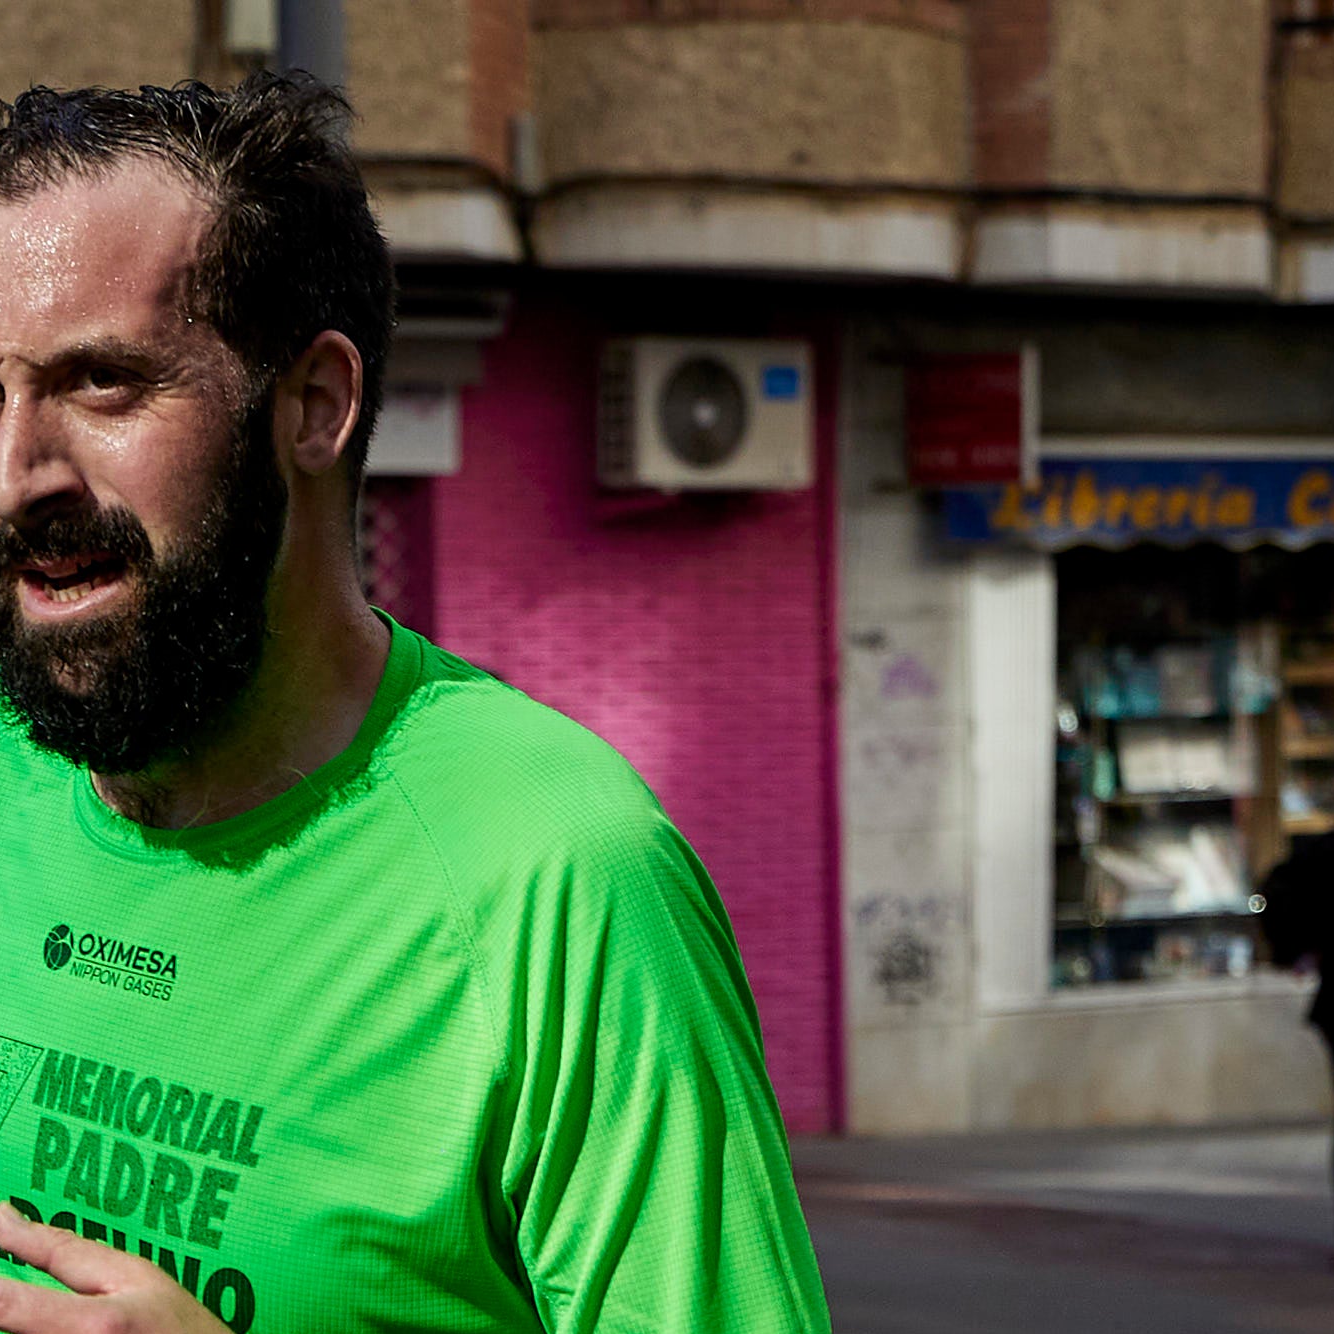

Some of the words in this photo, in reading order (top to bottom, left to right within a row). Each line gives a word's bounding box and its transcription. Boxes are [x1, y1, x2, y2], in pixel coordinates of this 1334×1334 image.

[69, 961, 121, 987] NIPPON
[123, 975, 173, 1001] GASES
[78, 933, 178, 979] OXIMESA
[32, 1048, 265, 1169] MEMORIAL
[30, 1116, 241, 1250] PADRE
